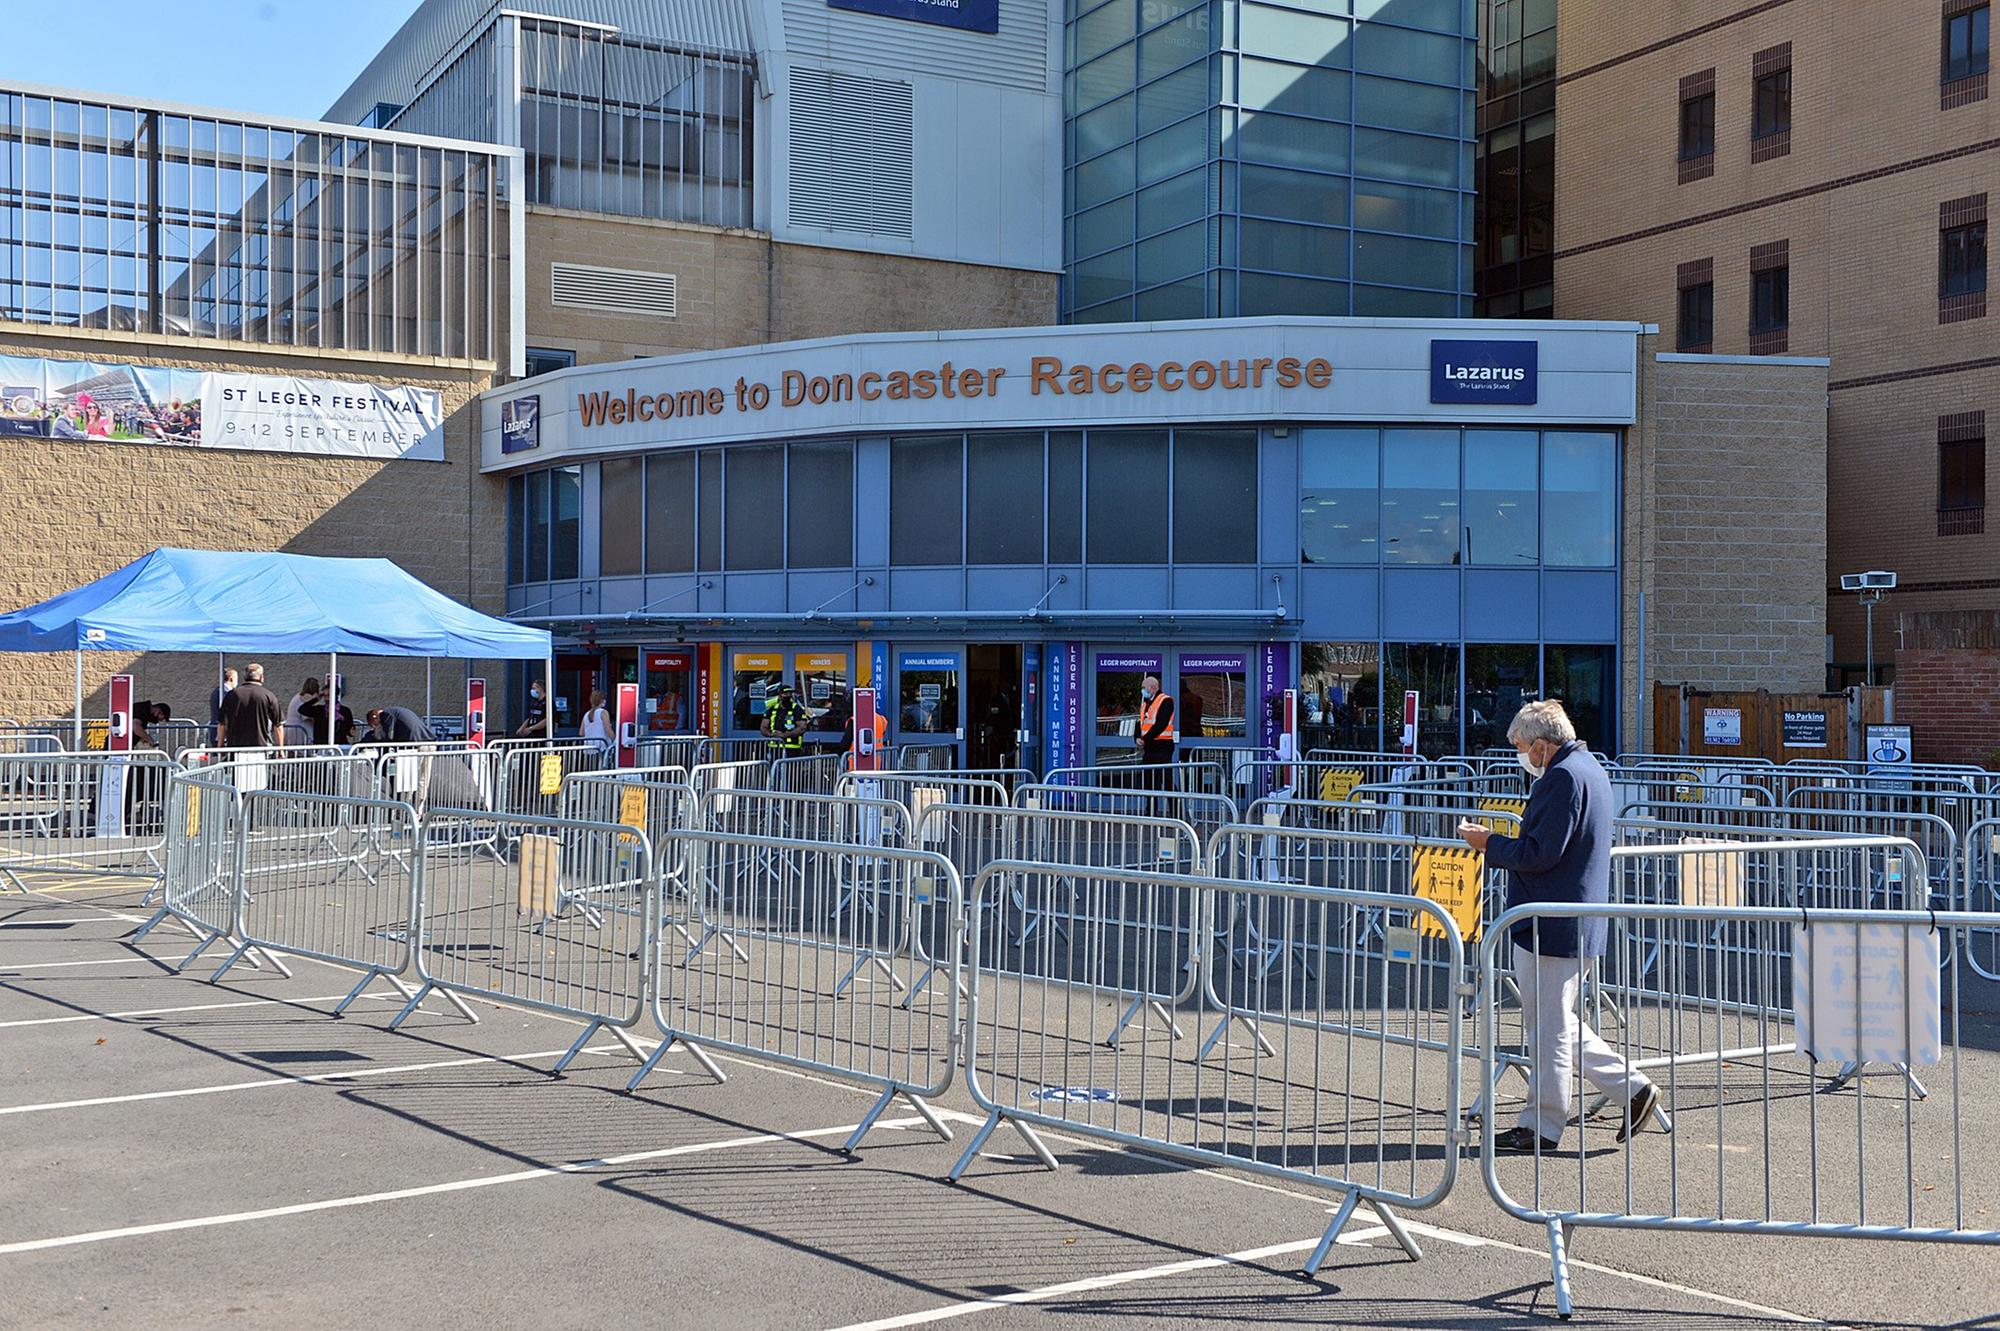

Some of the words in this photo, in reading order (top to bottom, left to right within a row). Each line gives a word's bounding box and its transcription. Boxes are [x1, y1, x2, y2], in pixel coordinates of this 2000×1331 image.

[1445, 363, 1525, 381] Lazarus
[577, 386, 725, 427] Welcome
[735, 376, 770, 412] to
[781, 360, 1006, 407] Doncaster
[1031, 355, 1333, 396] Racecourse
[1493, 382, 1510, 390] Stand
[223, 388, 247, 402] ST
[258, 390, 322, 407] LEGER
[332, 396, 424, 415] FESTIVAL
[503, 418, 532, 434] Lazarus
[225, 421, 272, 437] 9-12
[284, 425, 423, 446] SEPTEMBER
[904, 658, 926, 666] ANNUAL
[926, 658, 954, 666] MEMBERS
[1099, 659, 1119, 667] LEGER
[1119, 659, 1158, 667] HOSPITALITY
[1183, 659, 1203, 668] LEGER
[1203, 660, 1242, 668] HOSPITALITY
[1784, 712, 1796, 721] No
[1796, 712, 1825, 722] Parking
[1883, 741, 1894, 750] 1st
[1051, 721, 1060, 786] MEMBES
[1431, 861, 1464, 872] CAUTION
